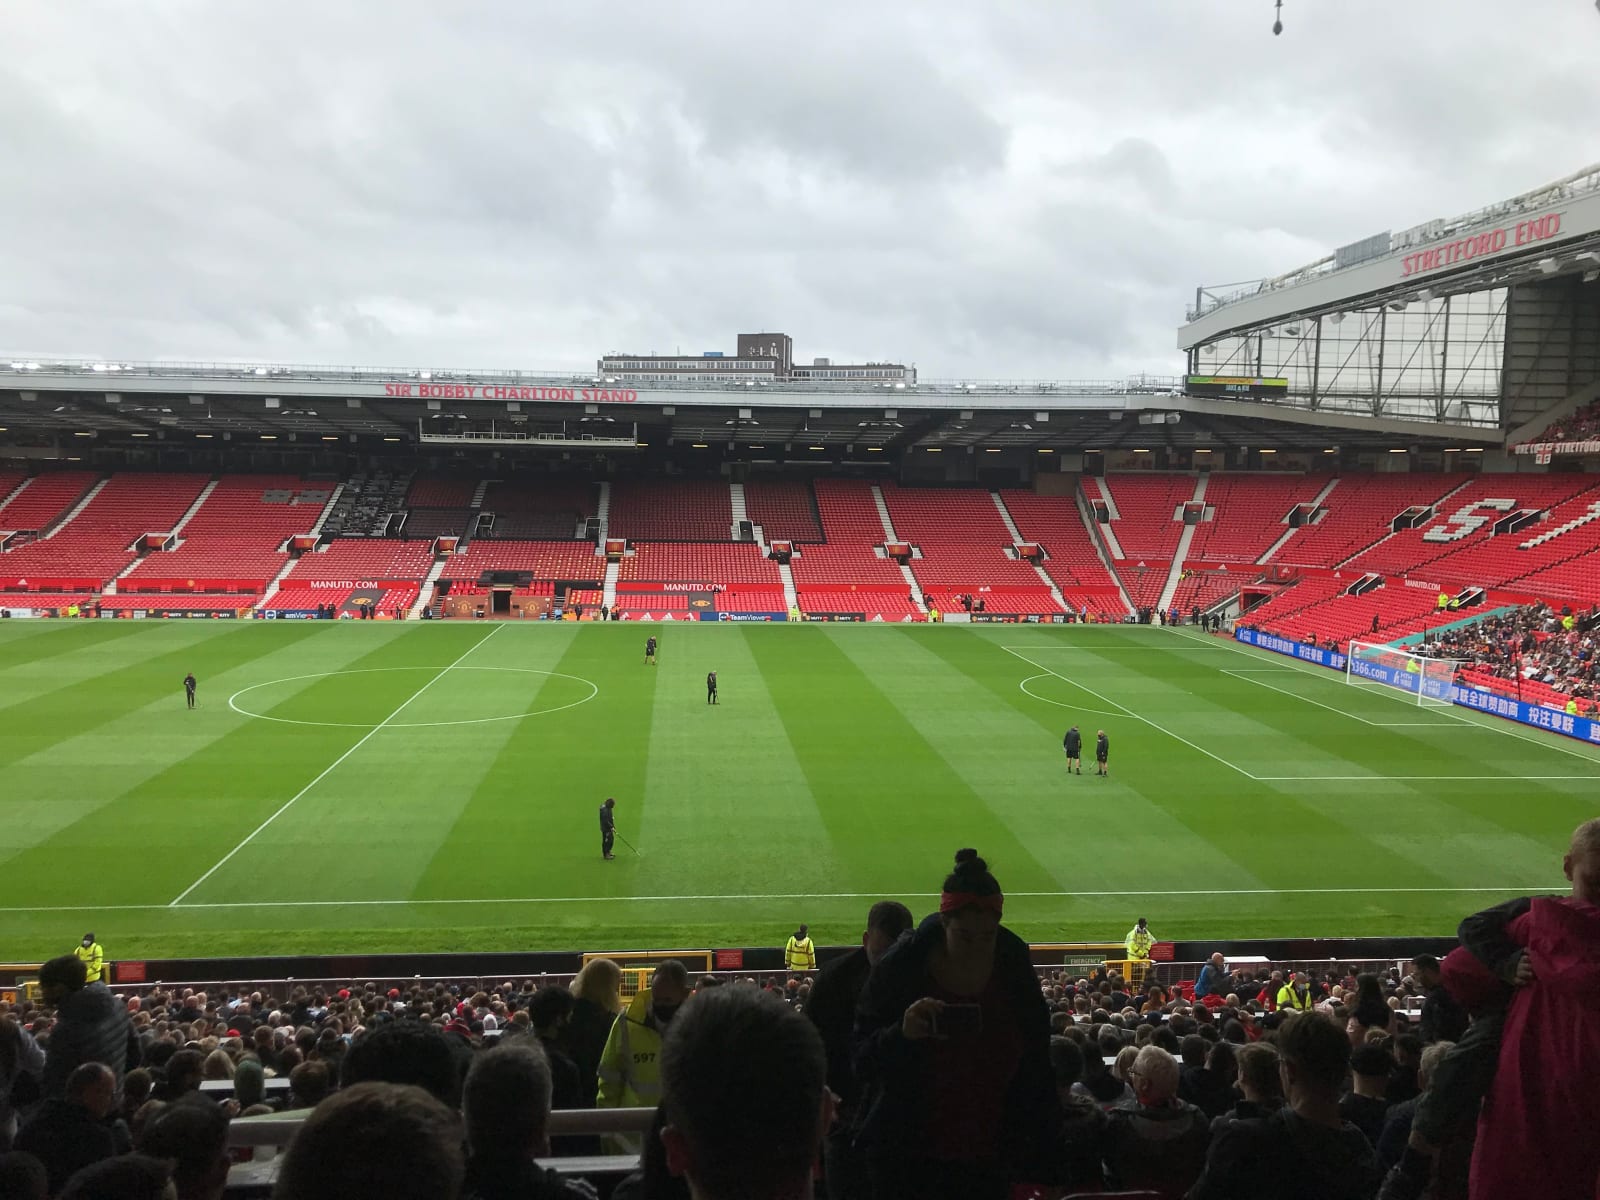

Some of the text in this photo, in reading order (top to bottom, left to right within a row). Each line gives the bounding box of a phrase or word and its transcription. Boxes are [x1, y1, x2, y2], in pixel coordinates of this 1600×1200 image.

[1402, 213, 1561, 277] STRETFORD END
[384, 383, 638, 403] SIR BOBBY CHARLTON STAND
[310, 580, 378, 589] MANUTD.COM
[663, 583, 727, 592] MANUTD.COM
[633, 1052, 656, 1064] 597
